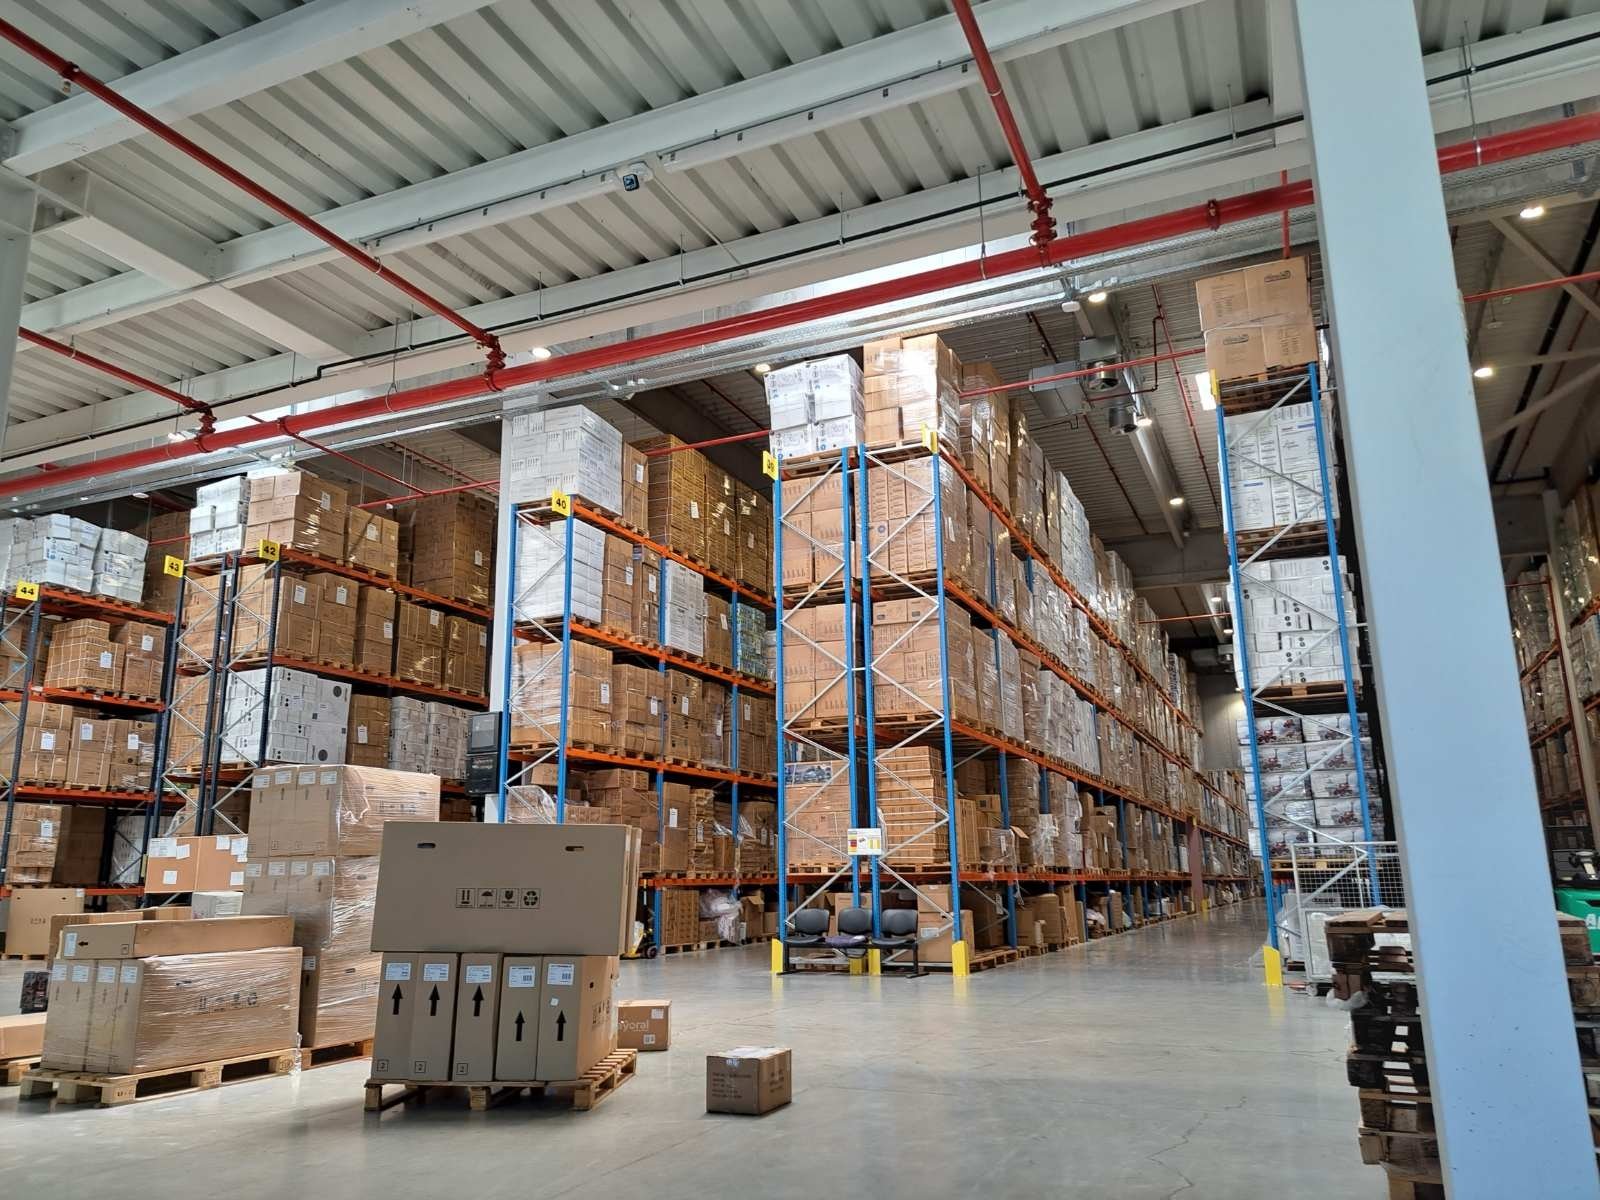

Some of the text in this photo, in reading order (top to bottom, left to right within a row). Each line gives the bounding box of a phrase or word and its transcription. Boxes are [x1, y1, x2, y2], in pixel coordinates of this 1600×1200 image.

[556, 498, 566, 510] 40
[263, 545, 276, 556] 42
[170, 562, 180, 572] 43
[20, 586, 35, 596] 44
